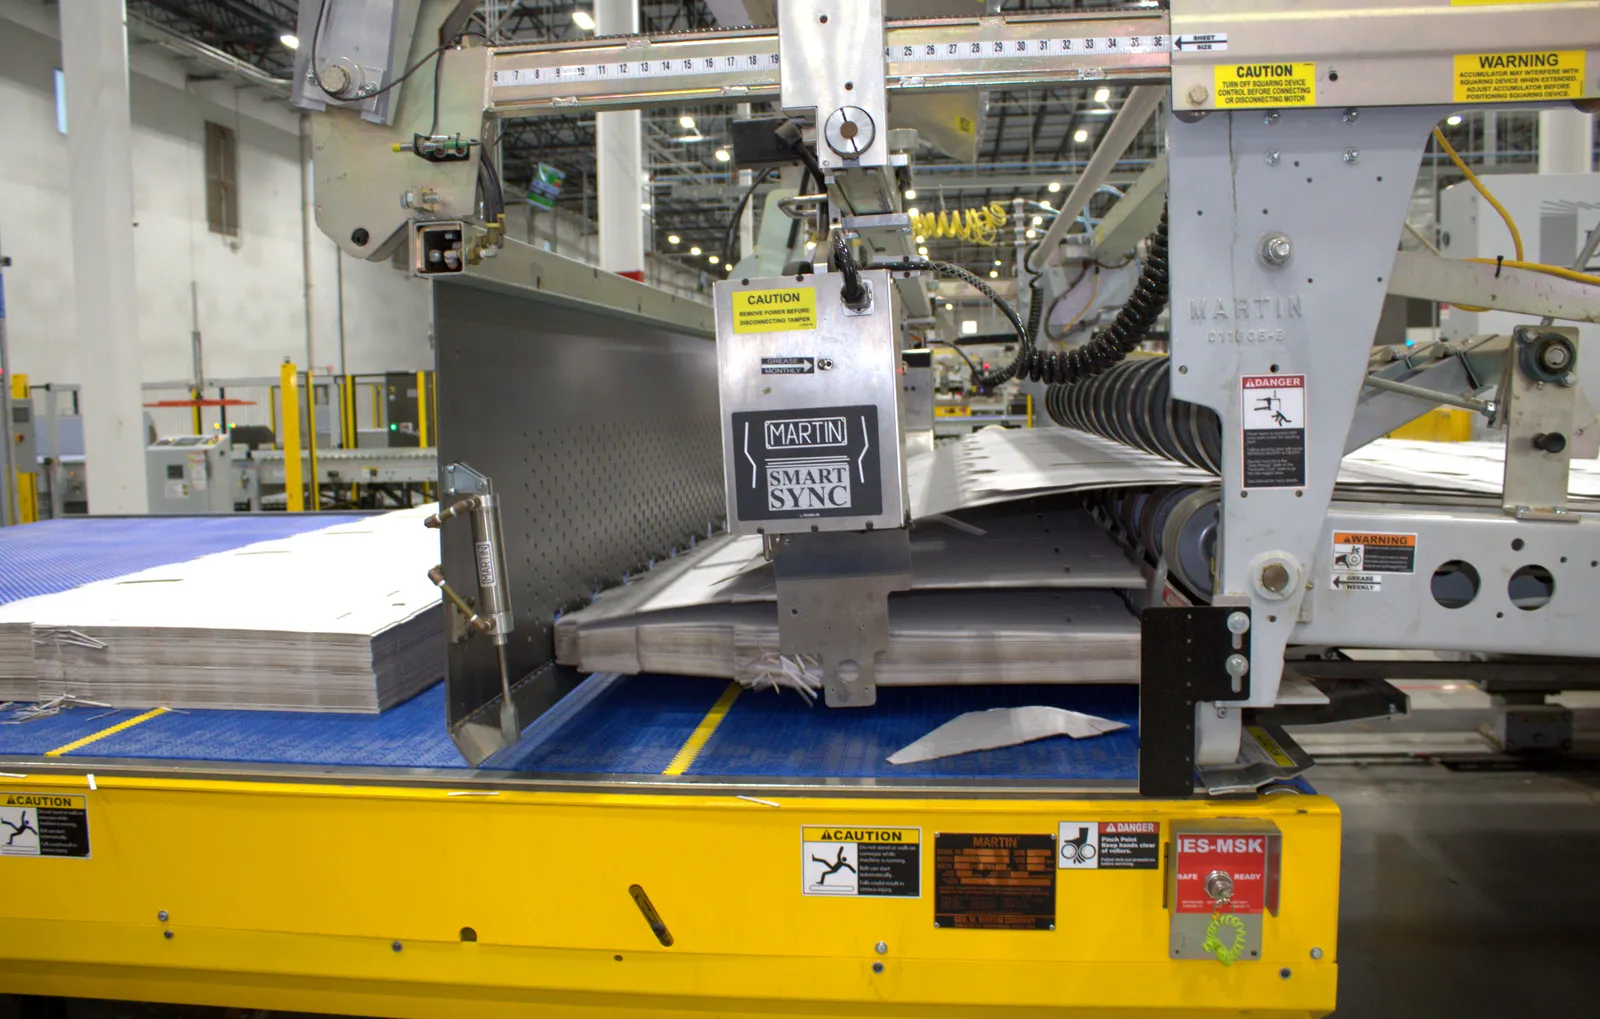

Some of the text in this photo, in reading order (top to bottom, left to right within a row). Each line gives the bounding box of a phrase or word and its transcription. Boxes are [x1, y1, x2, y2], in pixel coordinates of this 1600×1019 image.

[904, 46, 912, 56] 25
[926, 45, 935, 55] 26
[949, 44, 957, 54] 27
[972, 43, 980, 53] 28
[994, 42, 1002, 52] 29
[1017, 41, 1025, 51] 30
[1040, 40, 1048, 50] 31
[1062, 39, 1071, 49] 32
[1085, 39, 1094, 49] 33
[1108, 38, 1116, 48] 34
[1130, 37, 1140, 47] 35
[1154, 36, 1162, 47] 36
[494, 54, 779, 81] 6 7 8 9 10 11 12 13 14 15 16 17 18 19
[1479, 54, 1558, 68] WARNING
[1237, 65, 1292, 78] CAUTION
[747, 293, 800, 305] CAUTION
[1188, 297, 1302, 320] MARTIN
[740, 318, 786, 326] DISCONNECTING
[1255, 378, 1300, 387] DANGER
[770, 420, 842, 445] MARTIN
[770, 467, 847, 487] SMART
[770, 485, 848, 509] SYNC
[1352, 535, 1408, 545] WARNING
[479, 546, 492, 582] MARTIN
[17, 796, 72, 806] CAUTION
[1118, 823, 1154, 832] DANGER
[834, 831, 902, 841] CAUTION
[973, 837, 1017, 848] MARTIN
